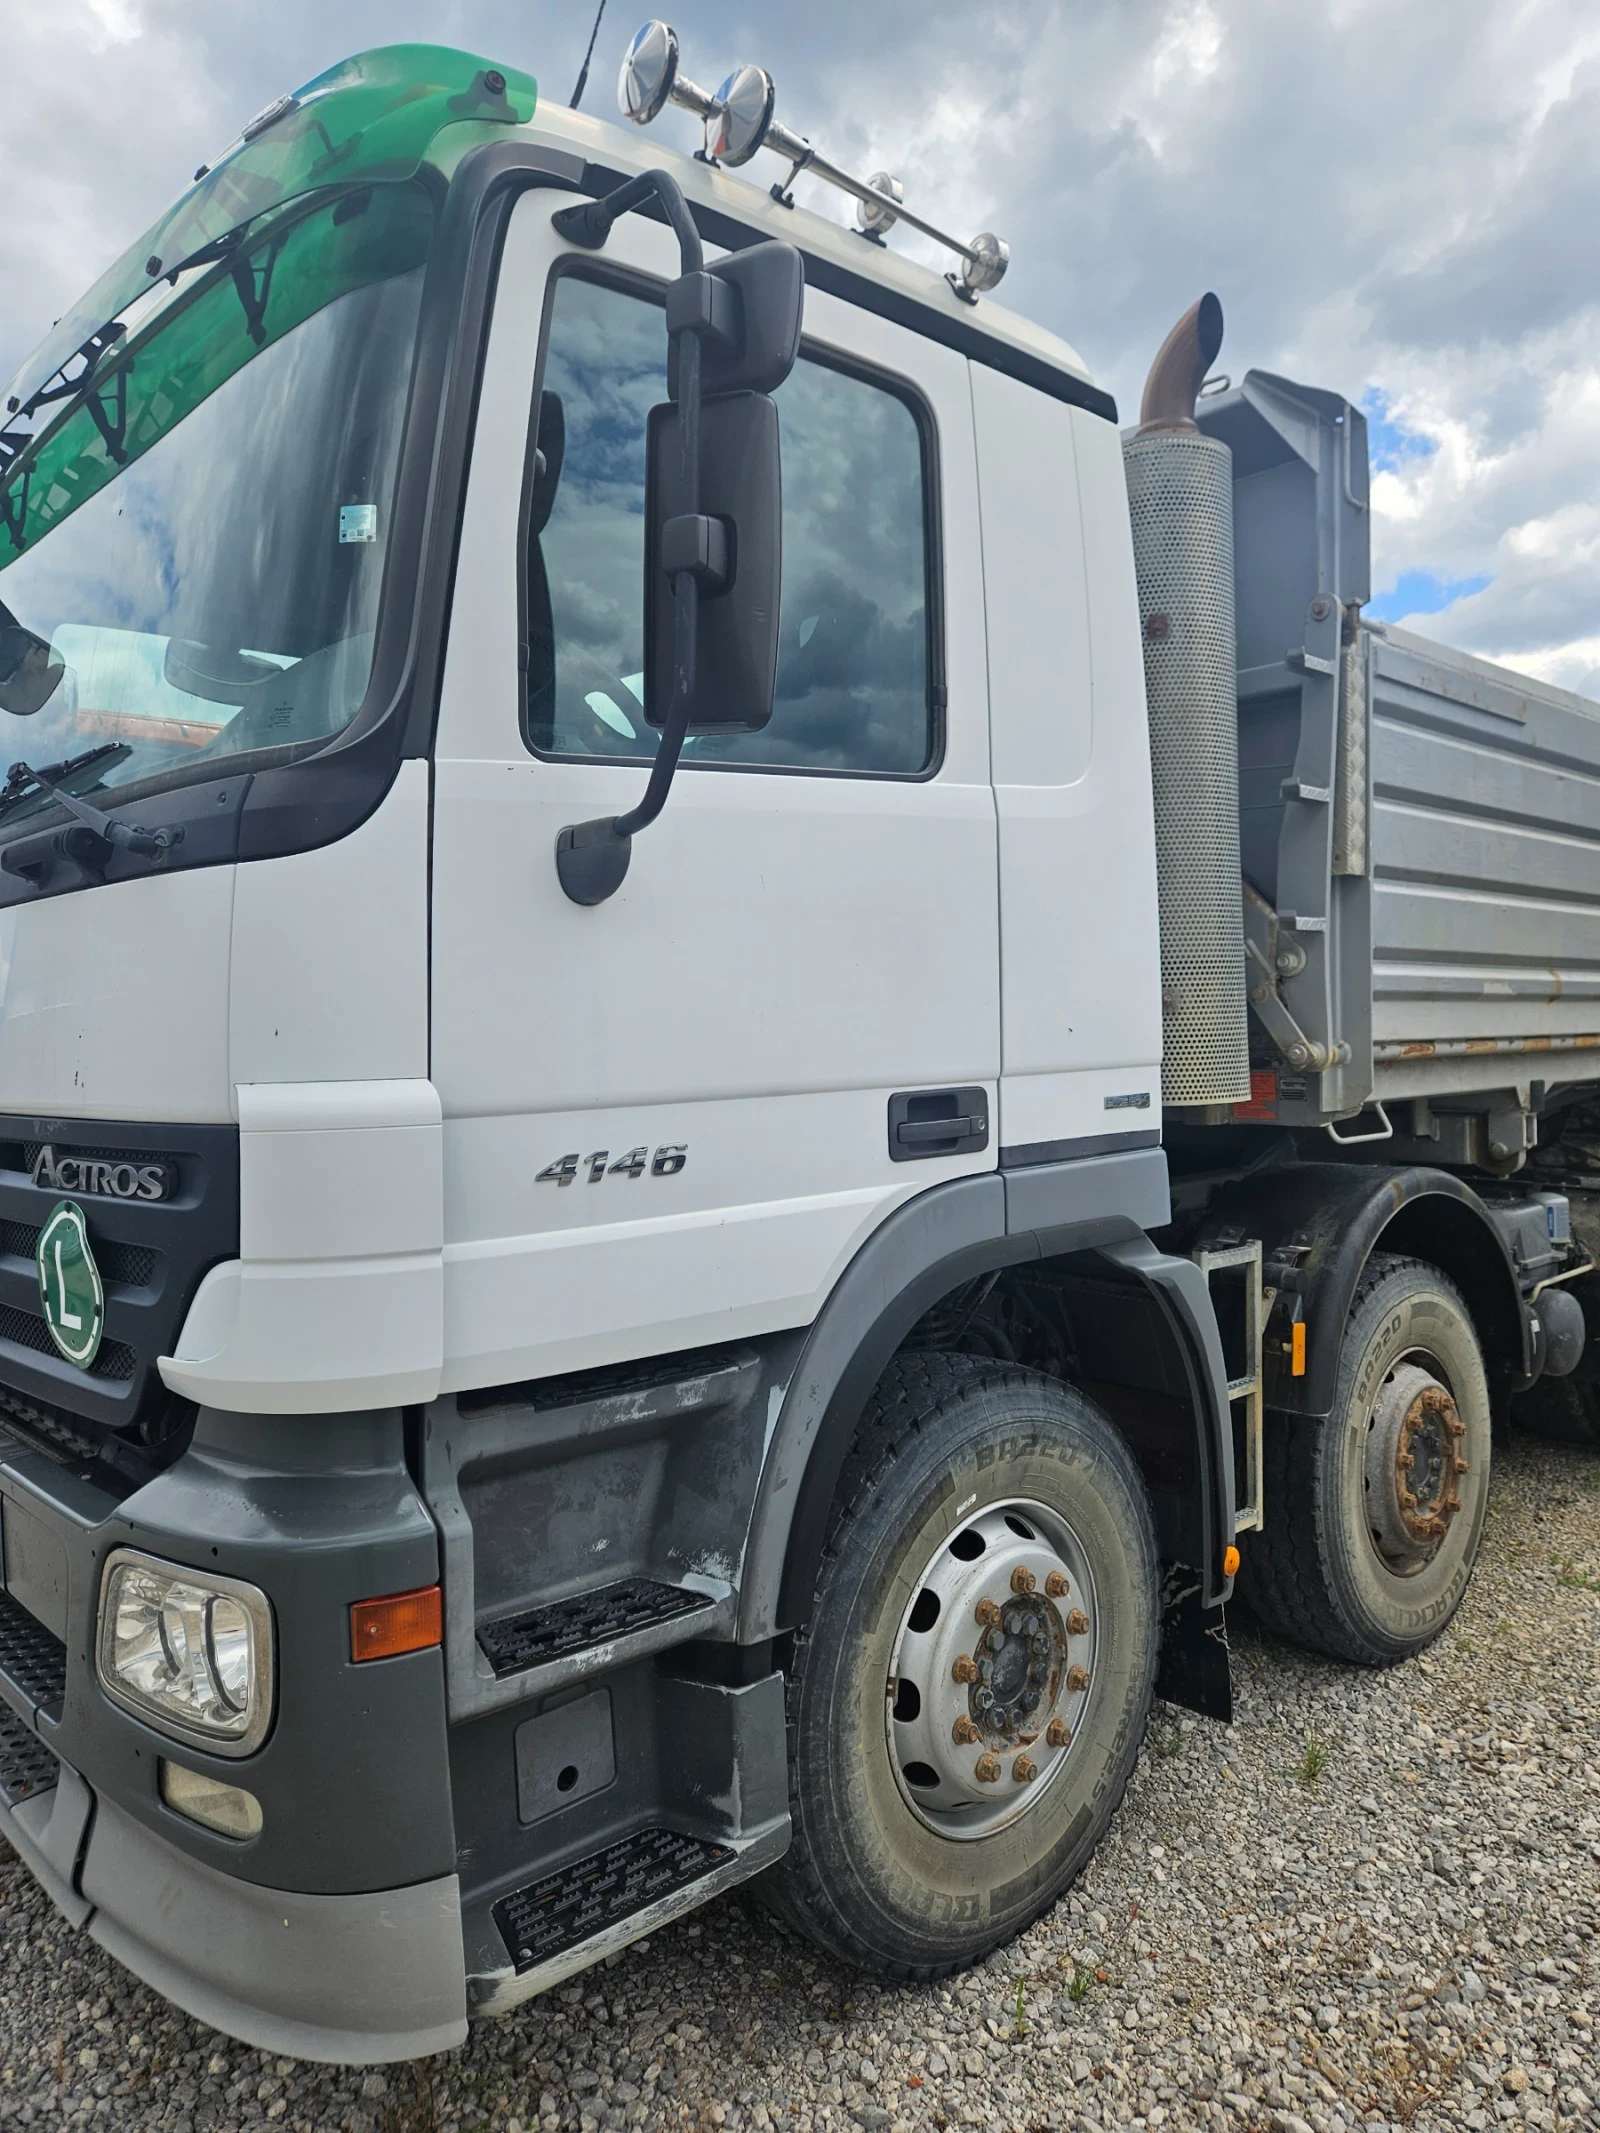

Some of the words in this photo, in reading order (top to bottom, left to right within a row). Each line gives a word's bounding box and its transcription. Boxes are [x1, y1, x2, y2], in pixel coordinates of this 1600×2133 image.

[534, 1142, 689, 1188] 4146
[54, 1240, 82, 1331] L
[1357, 1314, 1402, 1403] BA220
[975, 1433, 1080, 1473] BA220
